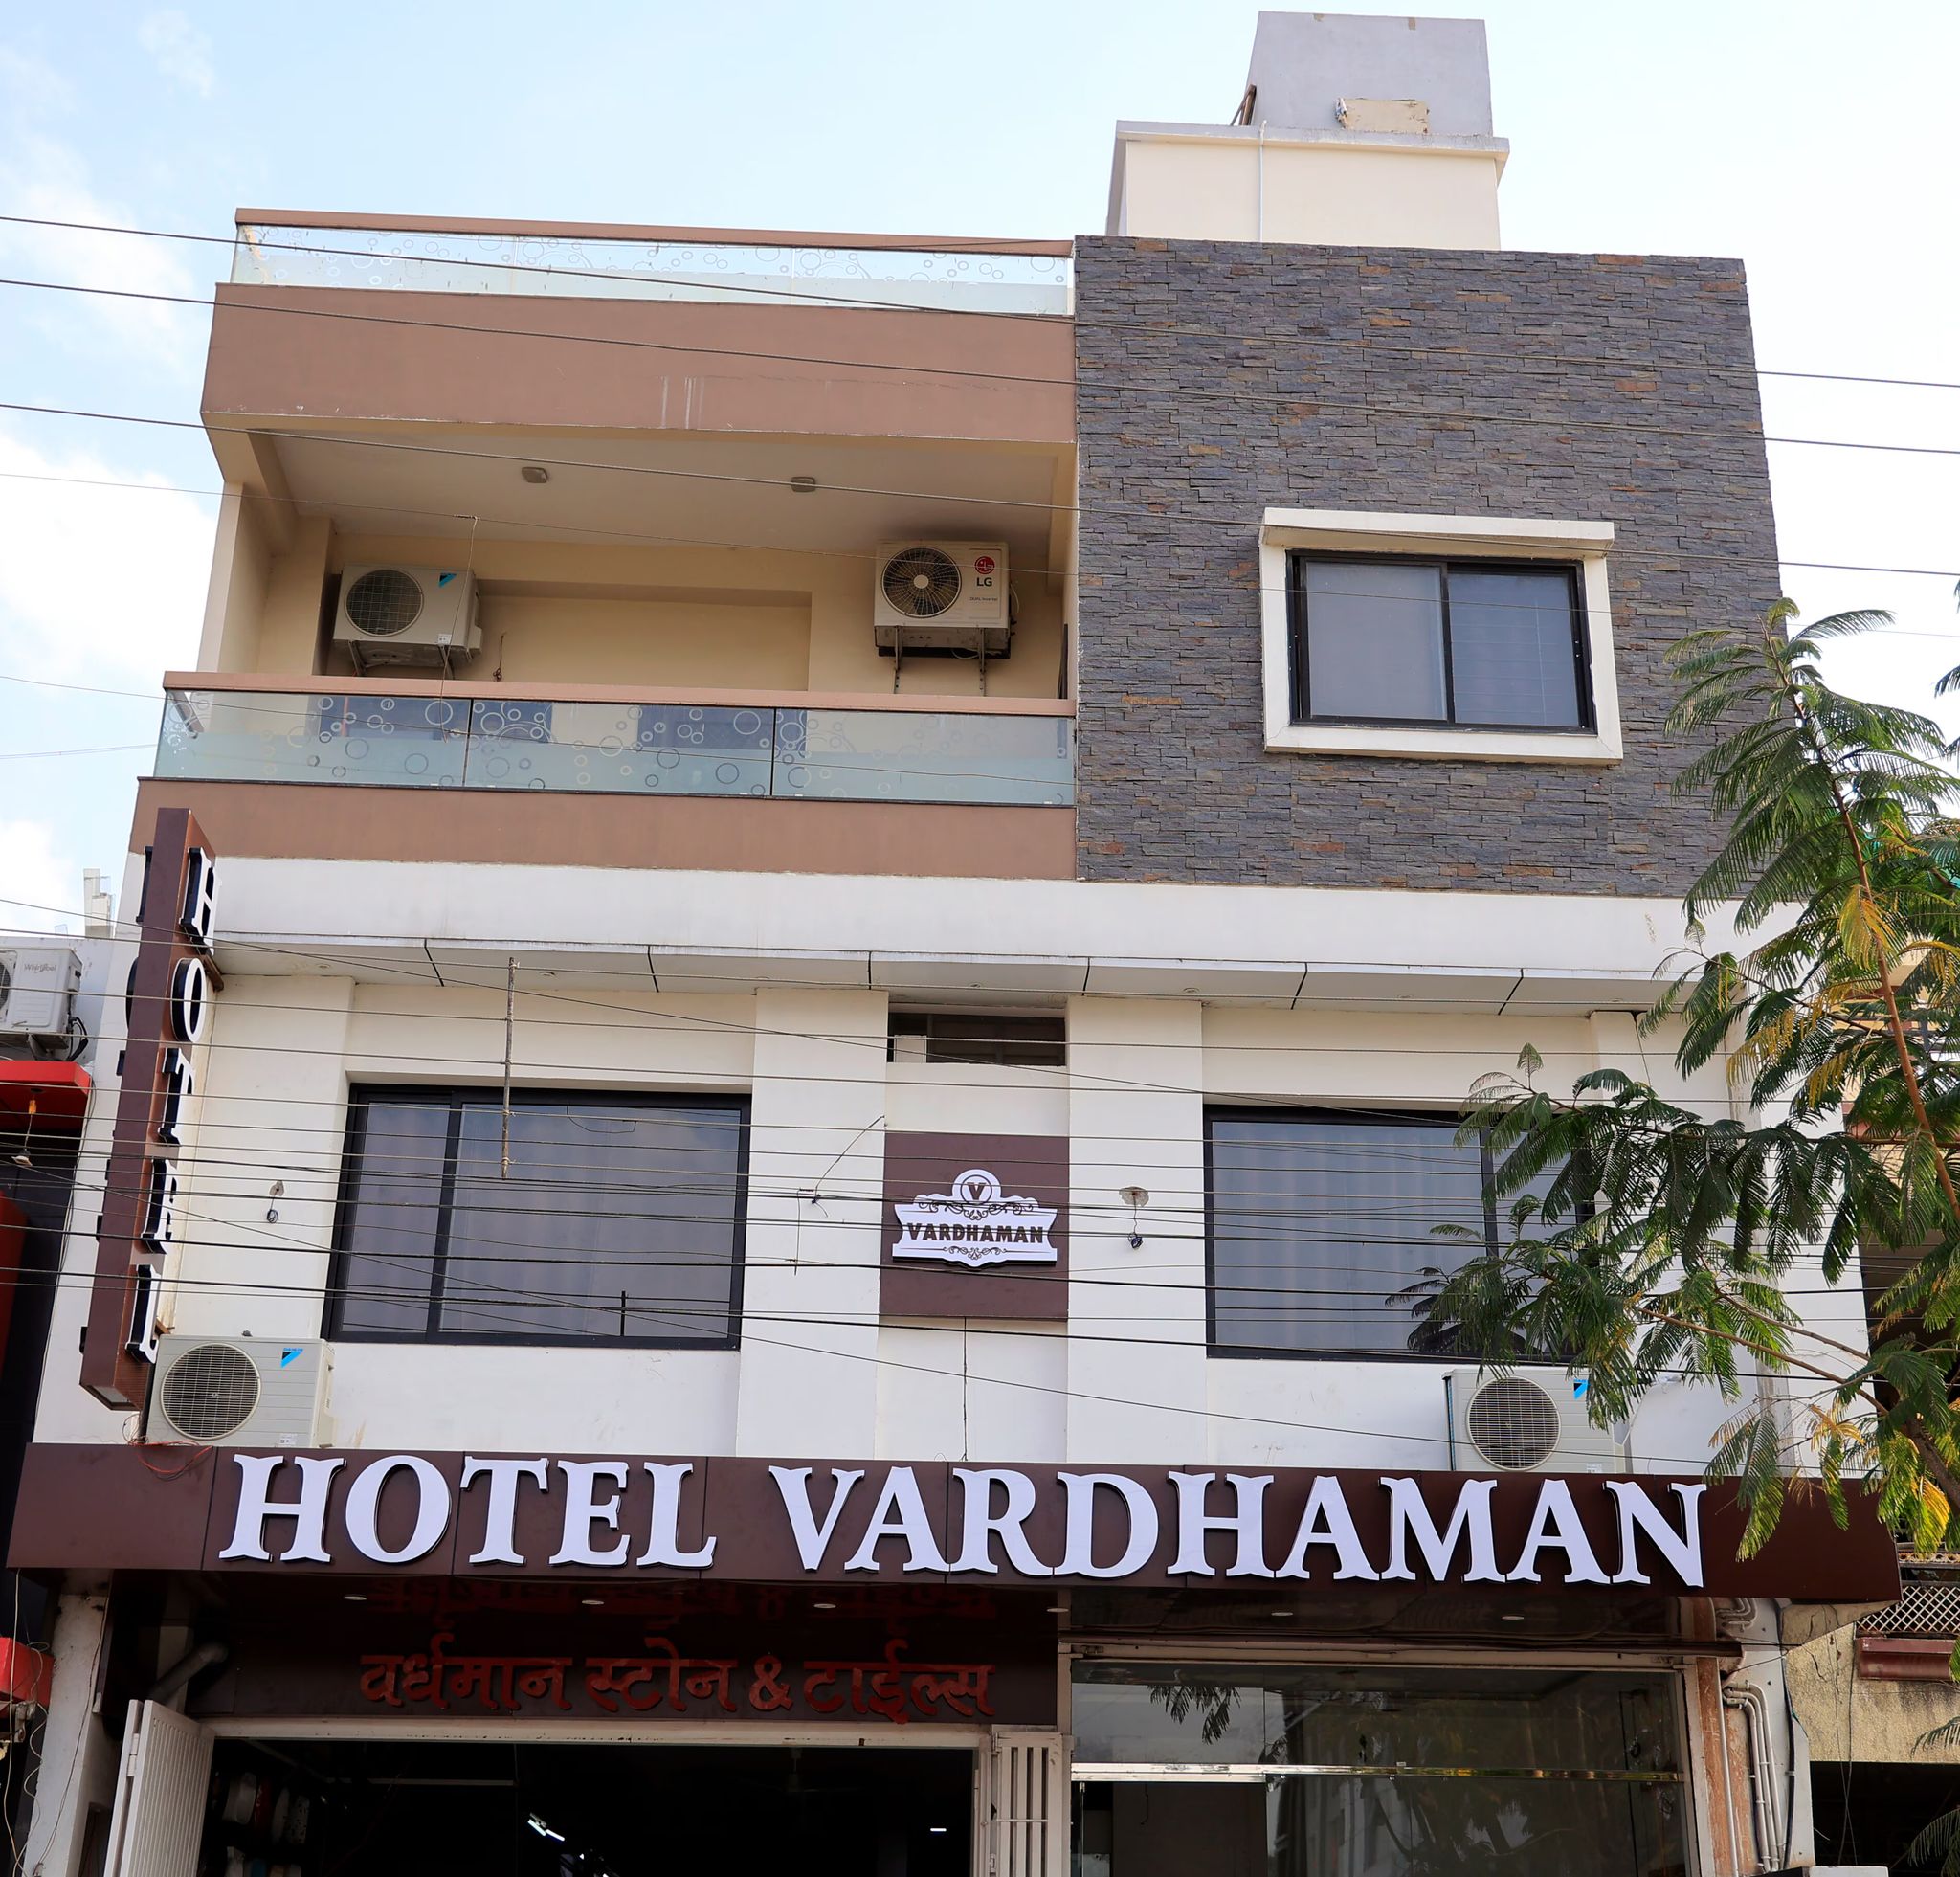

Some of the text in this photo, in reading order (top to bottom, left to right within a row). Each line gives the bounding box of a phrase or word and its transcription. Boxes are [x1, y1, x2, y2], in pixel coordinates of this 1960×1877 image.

[976, 577, 992, 587] LG
[967, 1182, 987, 1200] V
[907, 1223, 1044, 1244] VARDHAMAN
[218, 1454, 1707, 1588] HOTEL VARDHAMAN
[360, 1632, 996, 1724] वर्धमान स्टोन & टाईल्स
